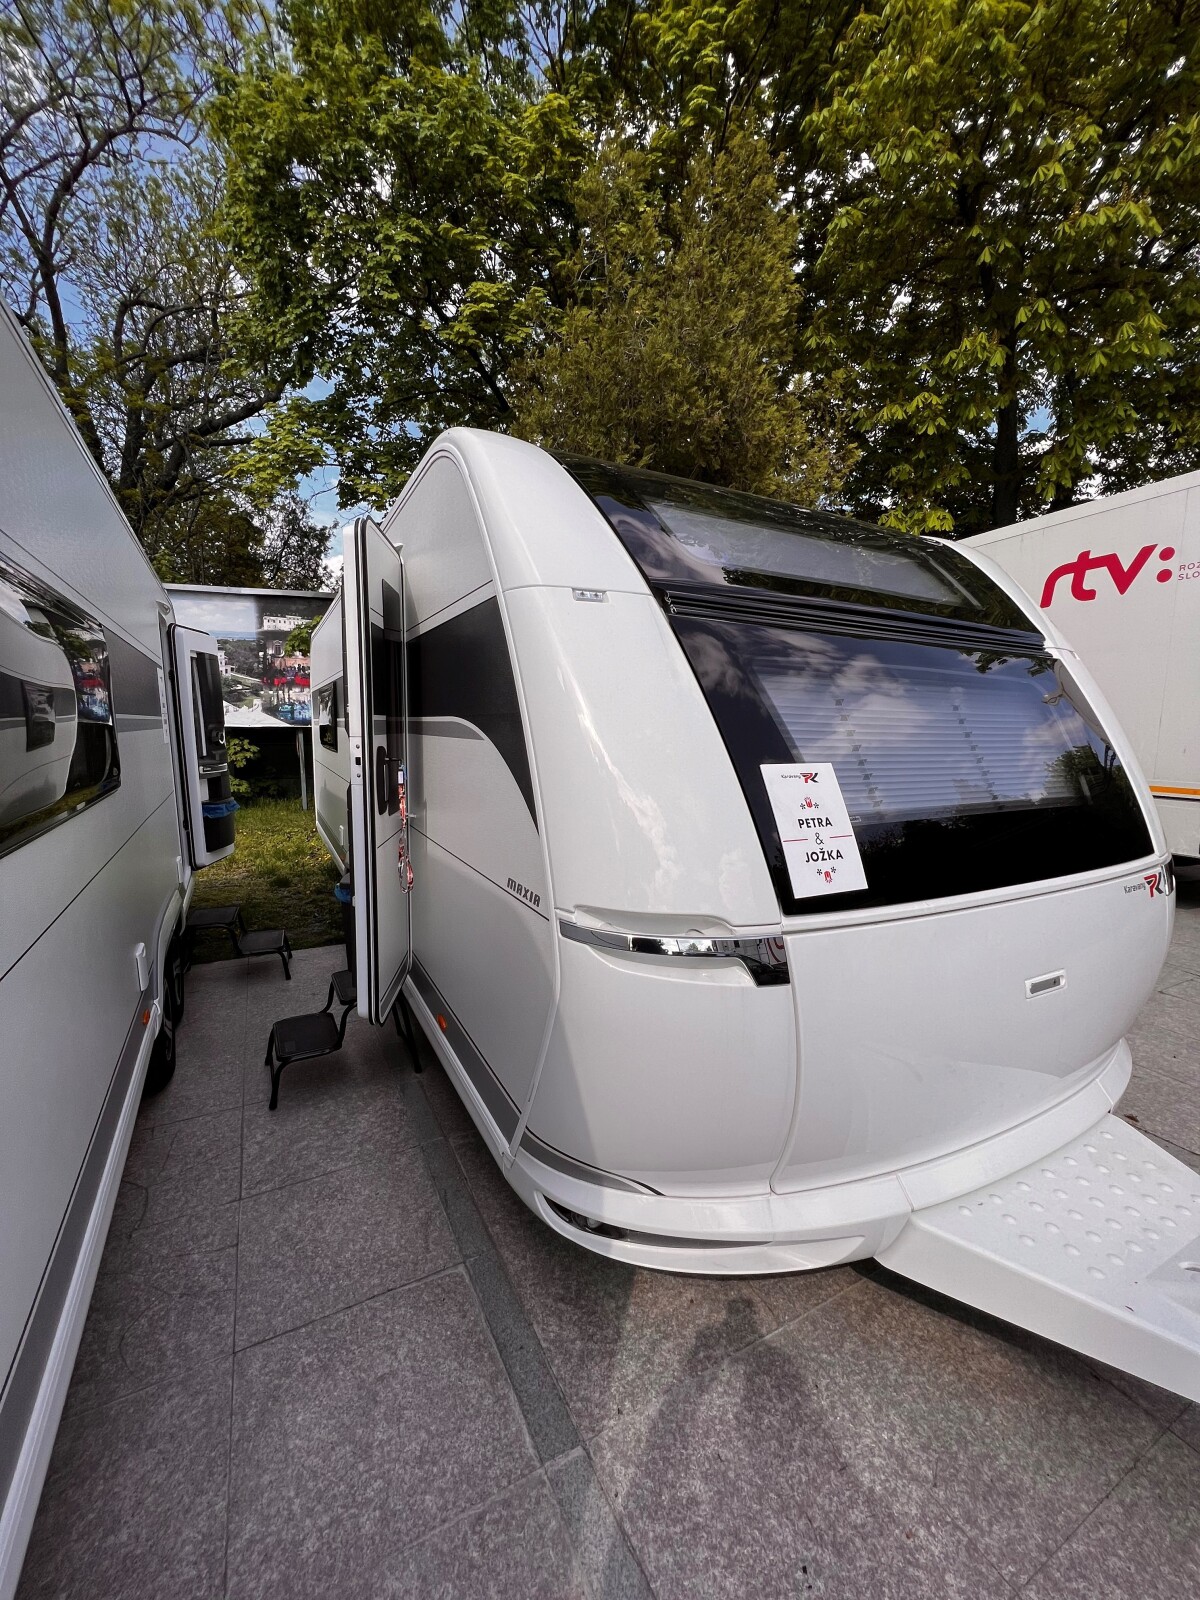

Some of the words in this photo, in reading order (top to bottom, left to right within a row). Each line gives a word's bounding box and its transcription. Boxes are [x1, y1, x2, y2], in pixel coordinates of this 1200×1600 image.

[798, 817, 833, 829] PETRA
[815, 832, 824, 845] &
[805, 848, 844, 863] JOŽKA
[507, 878, 541, 908] MAXIA
